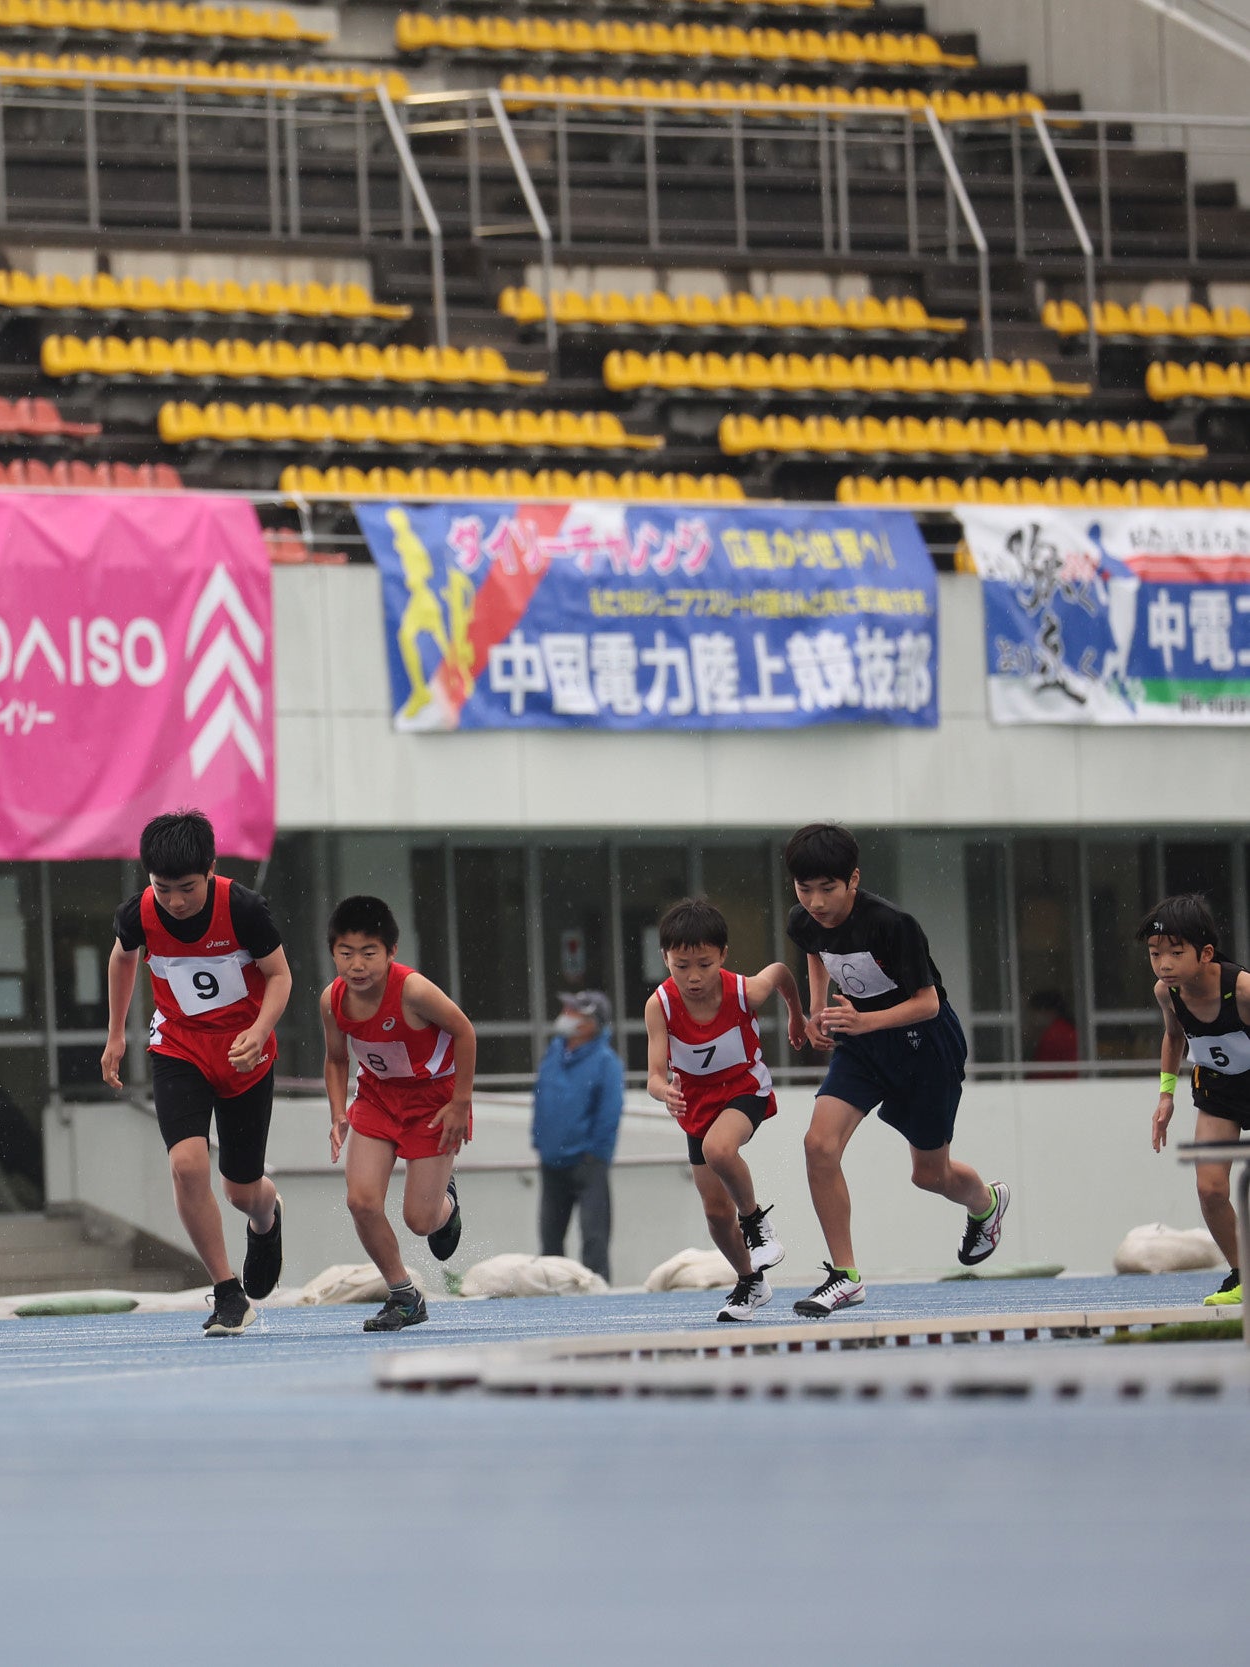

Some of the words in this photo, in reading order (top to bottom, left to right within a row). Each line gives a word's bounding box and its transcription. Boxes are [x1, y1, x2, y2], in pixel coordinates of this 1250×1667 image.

[447, 514, 714, 577] ダイソーチャレンジ
[487, 629, 933, 716] 中国電力陸上競技部
[192, 971, 220, 1000] 9
[841, 963, 866, 994] 6
[367, 1053, 388, 1072] 8
[693, 1045, 717, 1069] 7
[1209, 1046, 1230, 1068] 5
